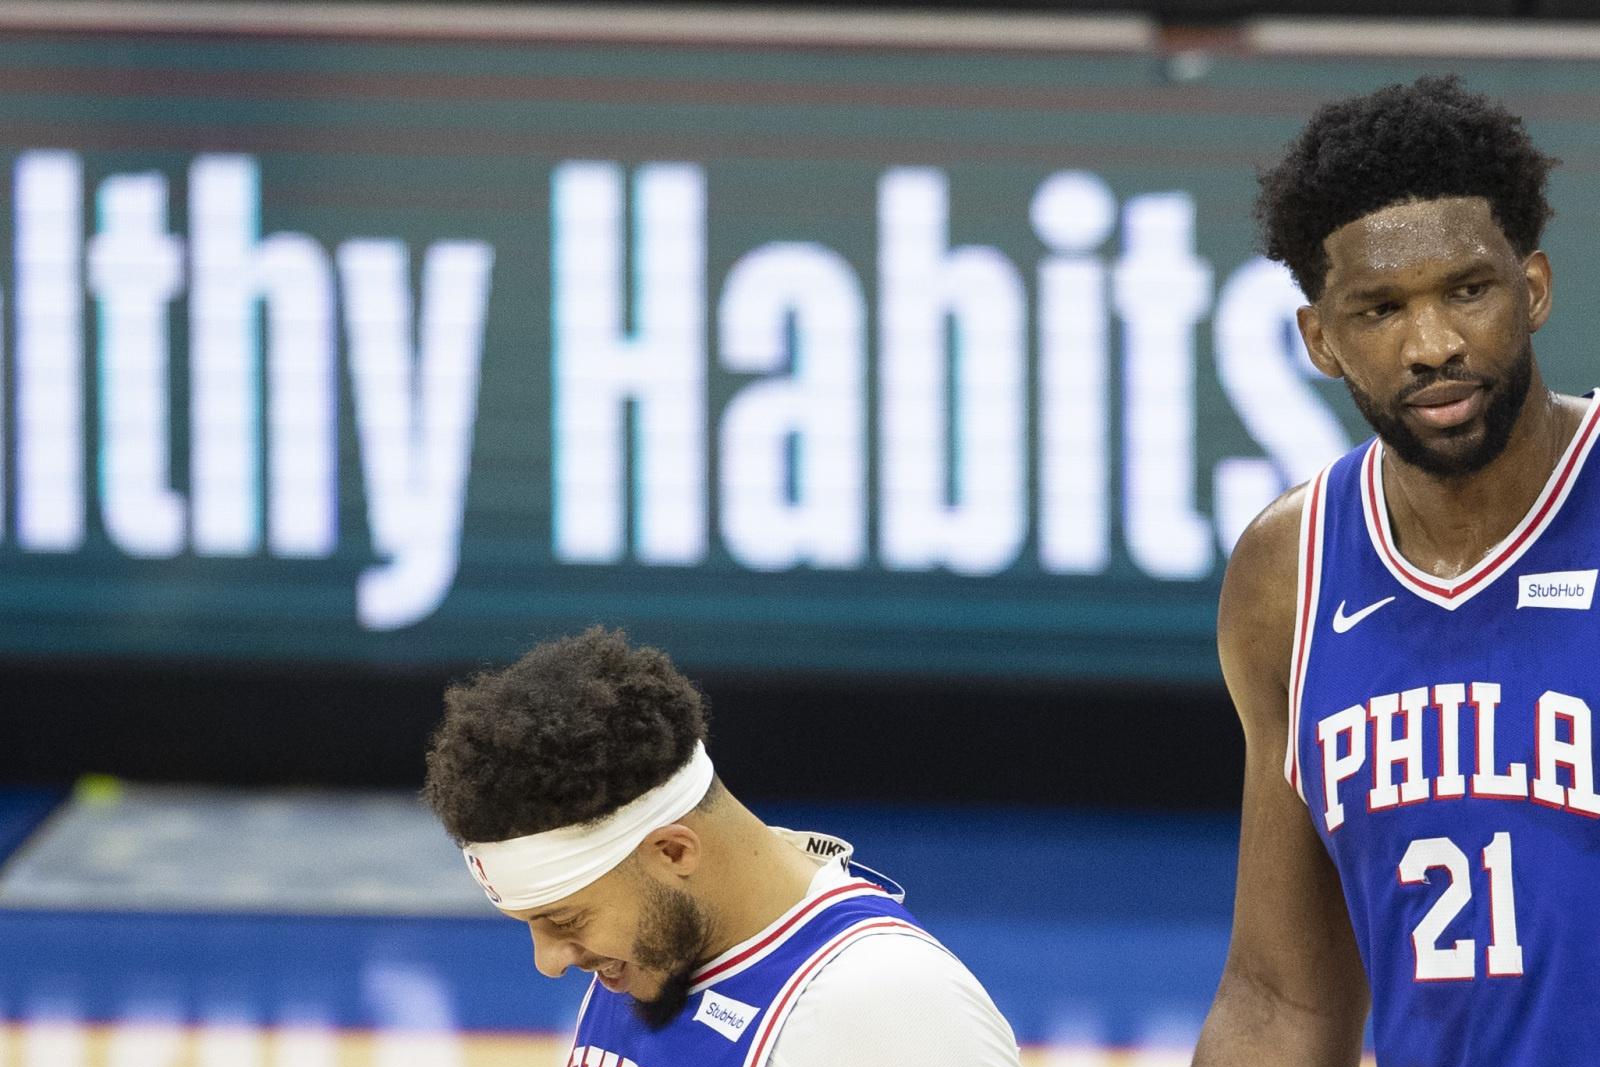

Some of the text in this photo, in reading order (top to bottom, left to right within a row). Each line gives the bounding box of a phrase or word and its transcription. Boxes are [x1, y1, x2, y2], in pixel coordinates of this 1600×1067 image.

[0, 150, 1350, 630] lthy Habits
[1527, 583, 1585, 598] StubHub
[1397, 832, 1524, 983] 21
[705, 1002, 745, 1029] StubHub
